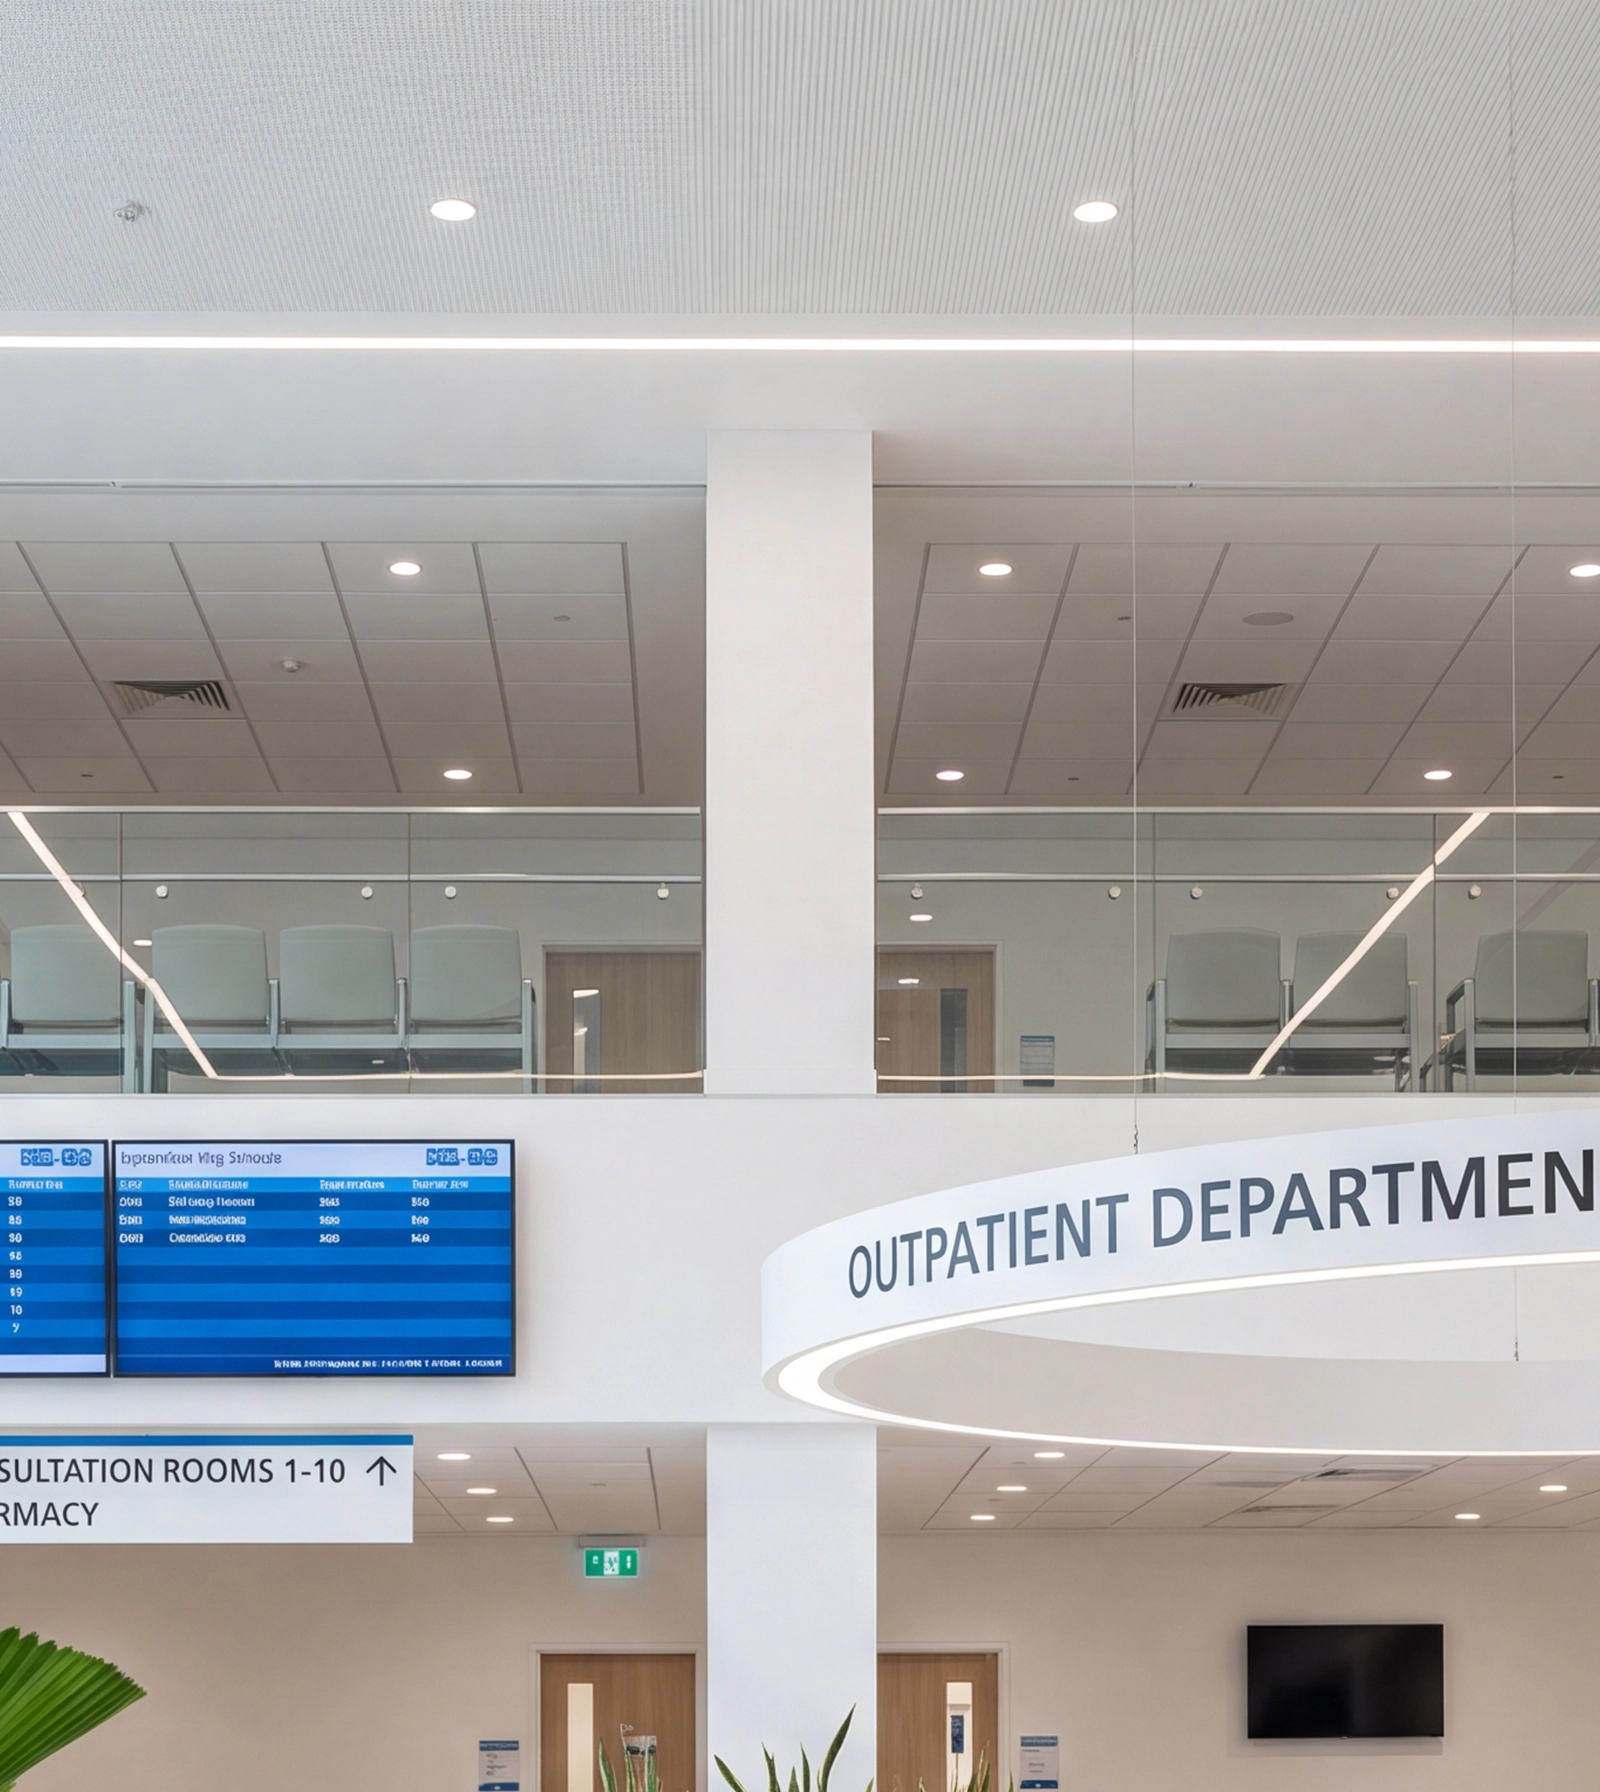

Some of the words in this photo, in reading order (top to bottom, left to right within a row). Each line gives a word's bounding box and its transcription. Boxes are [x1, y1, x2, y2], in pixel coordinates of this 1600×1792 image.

[848, 1193, 1129, 1300] OUTPATIENT
[164, 1457, 274, 1483] ROOMS
[285, 1458, 345, 1484] 1-10
